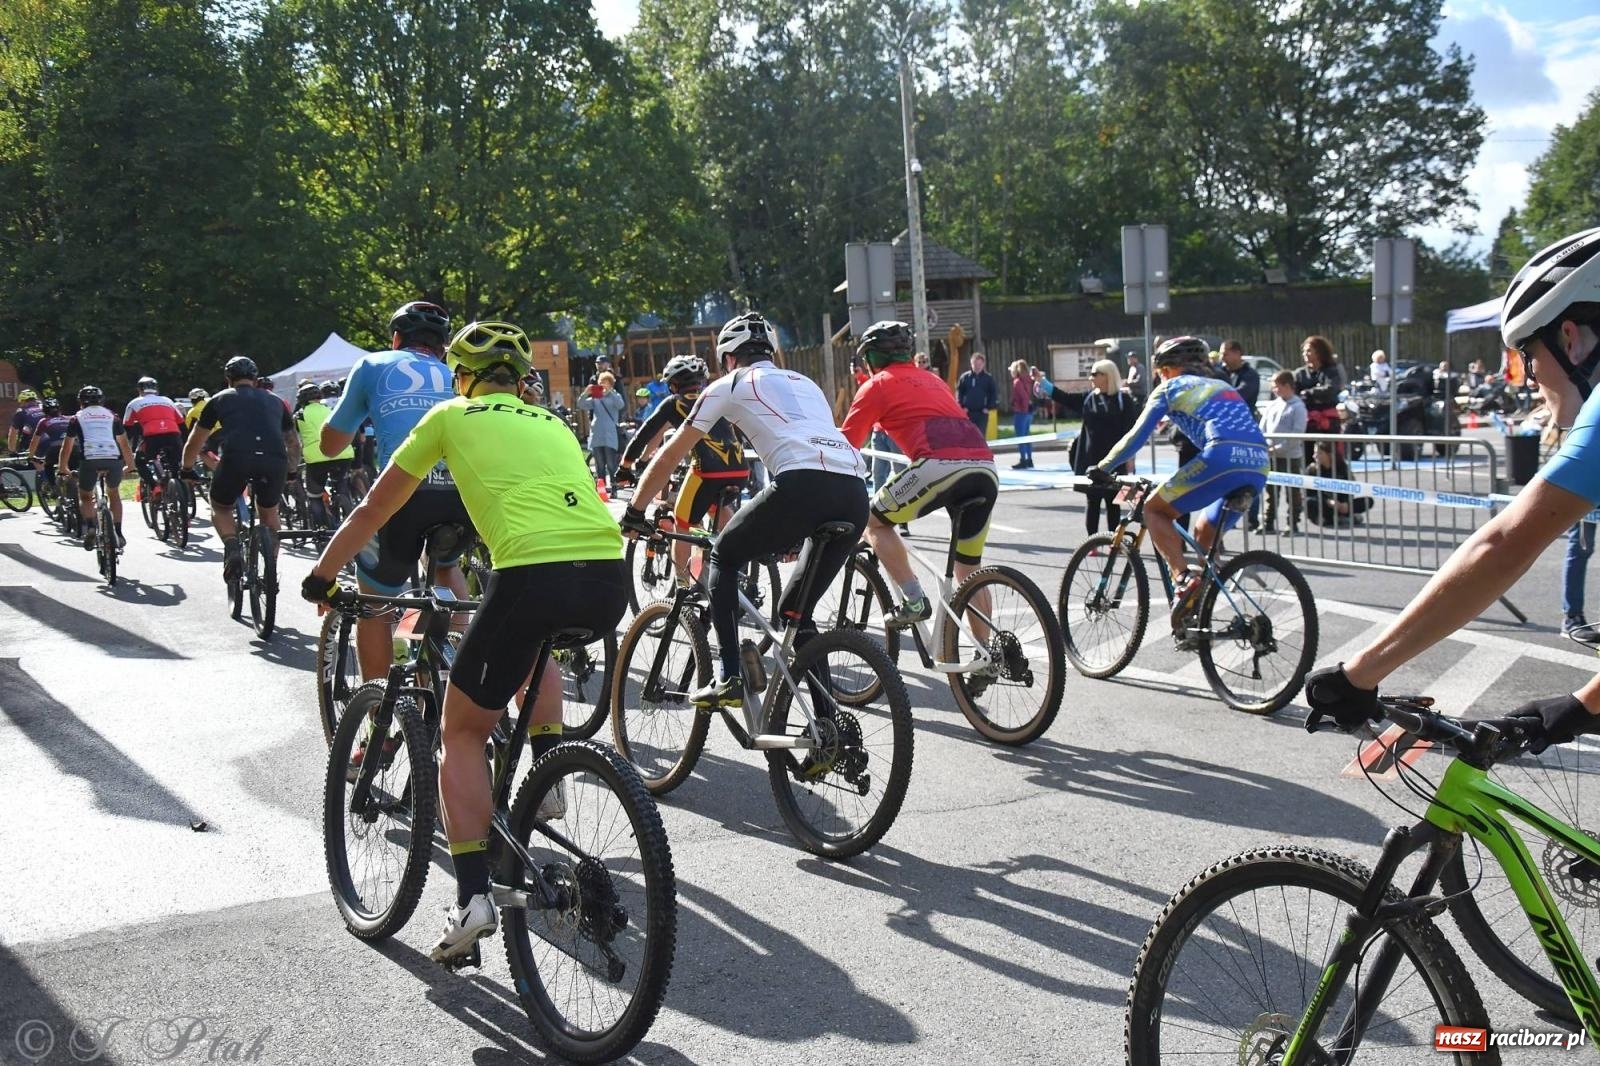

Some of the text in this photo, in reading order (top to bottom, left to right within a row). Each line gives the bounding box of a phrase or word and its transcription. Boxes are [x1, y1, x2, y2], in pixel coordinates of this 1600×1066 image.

[380, 398, 436, 413] CYCLIN
[464, 403, 559, 422] SCOT
[894, 472, 919, 498] AUTHOR
[1313, 479, 1362, 494] SHIMANO
[1372, 486, 1425, 501] SHIMANO
